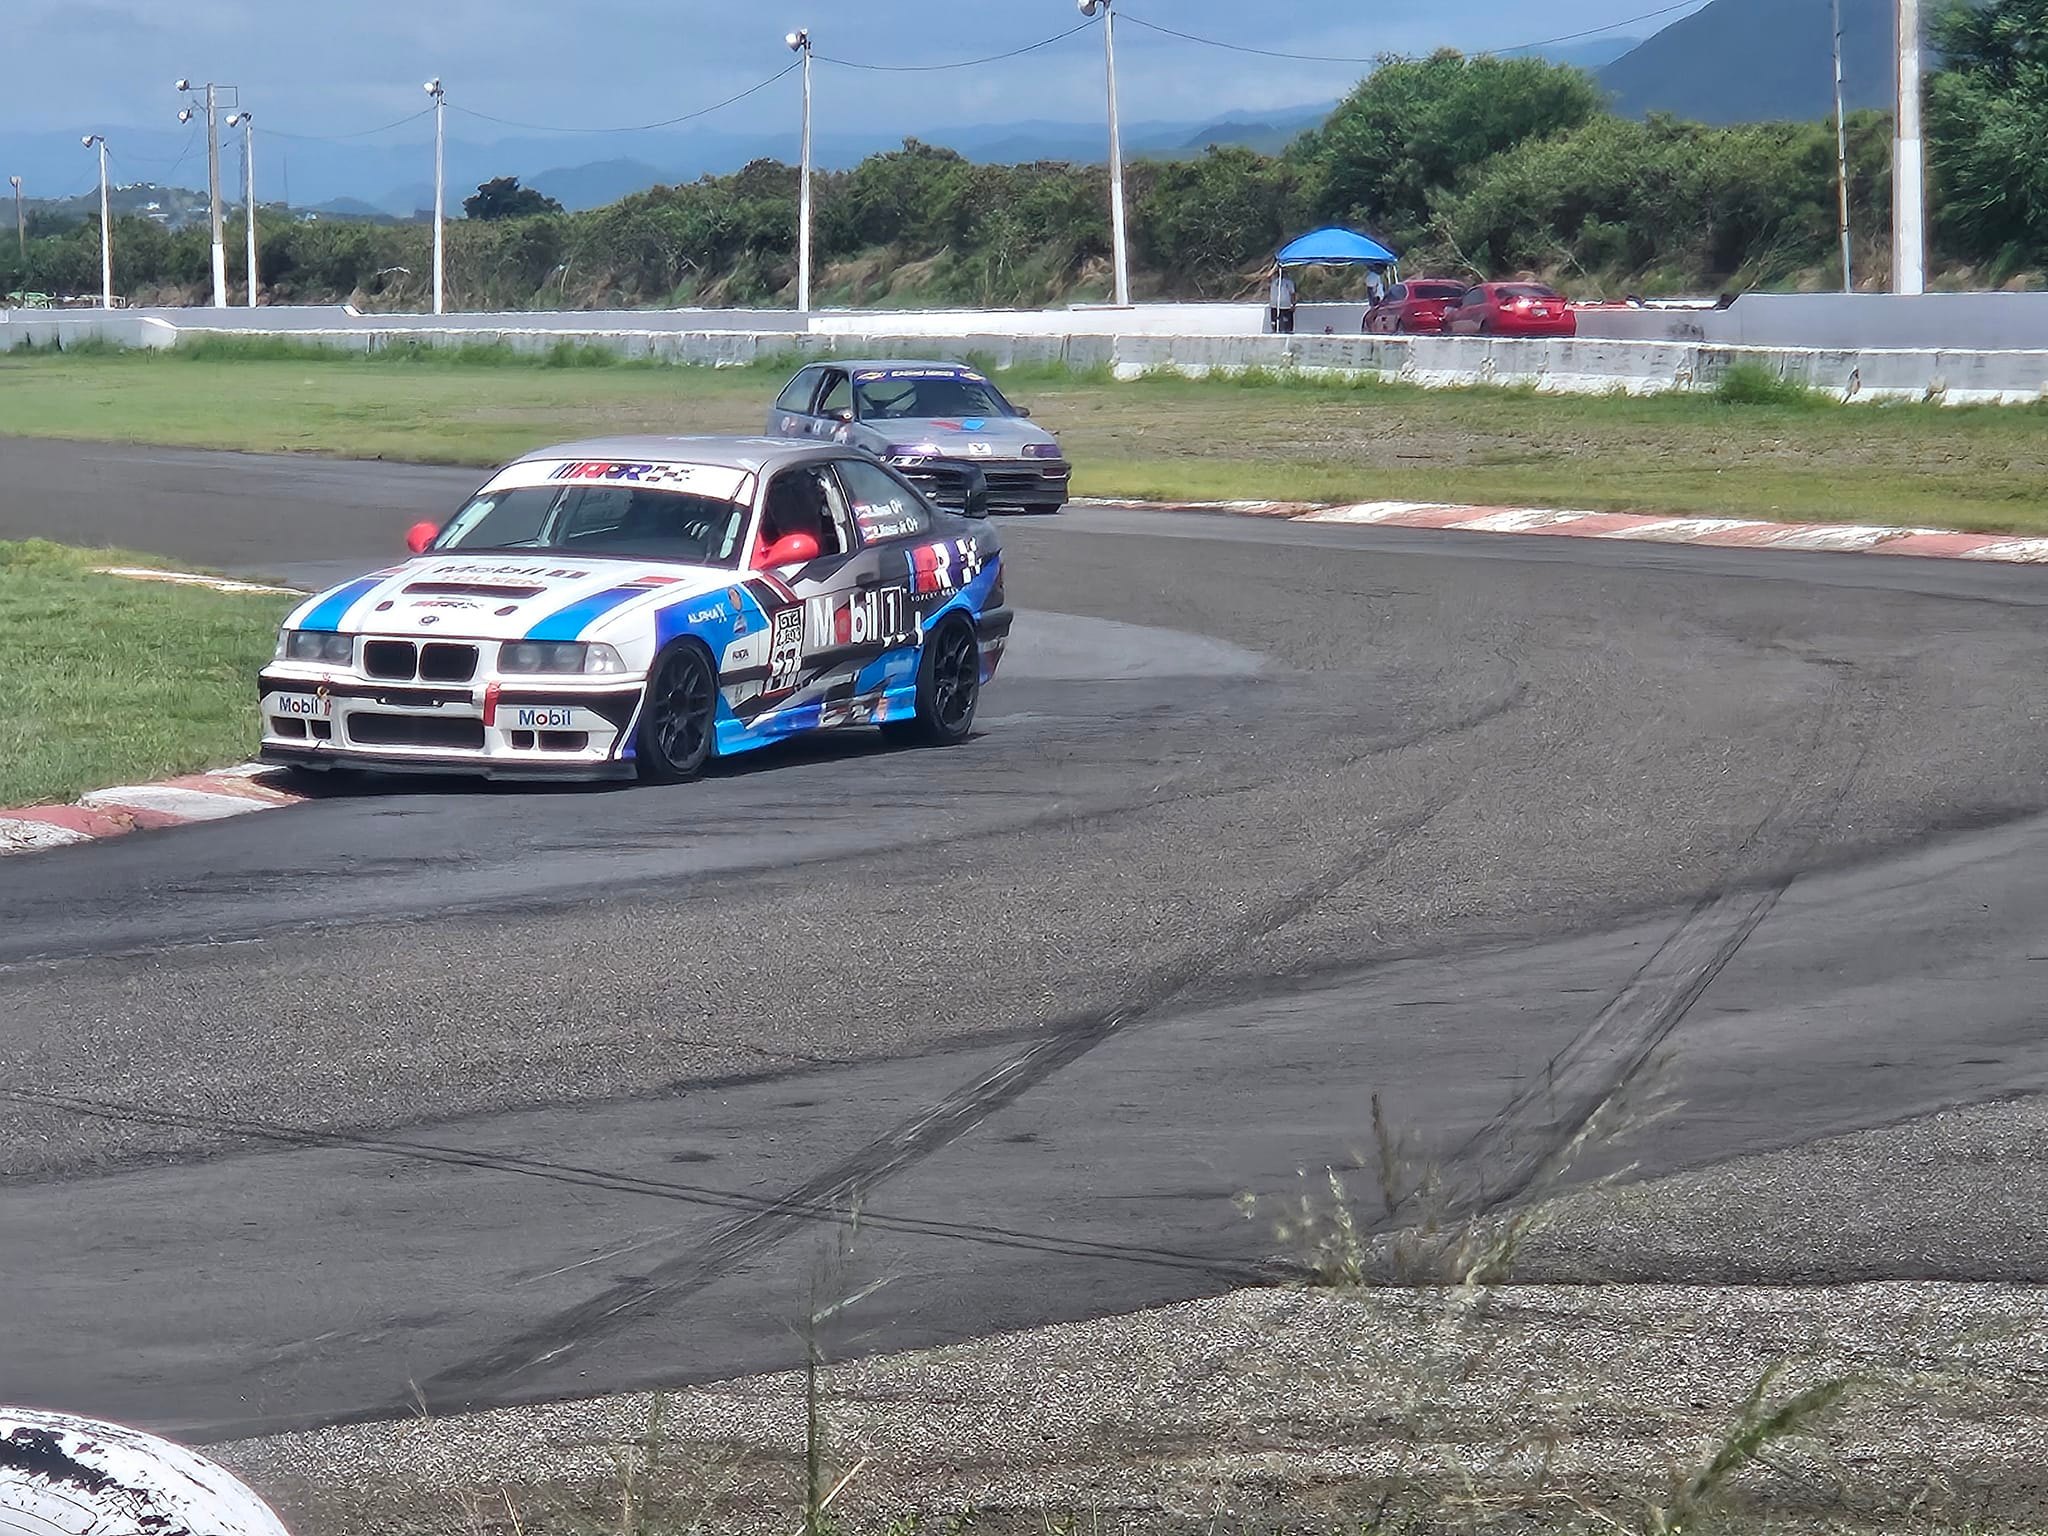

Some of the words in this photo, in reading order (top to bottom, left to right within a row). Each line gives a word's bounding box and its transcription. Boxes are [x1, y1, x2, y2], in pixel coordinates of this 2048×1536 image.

[433, 565, 547, 576] Mobil
[812, 592, 878, 646] Mobil
[279, 696, 319, 714] Mobil
[519, 709, 571, 726] Mobil
